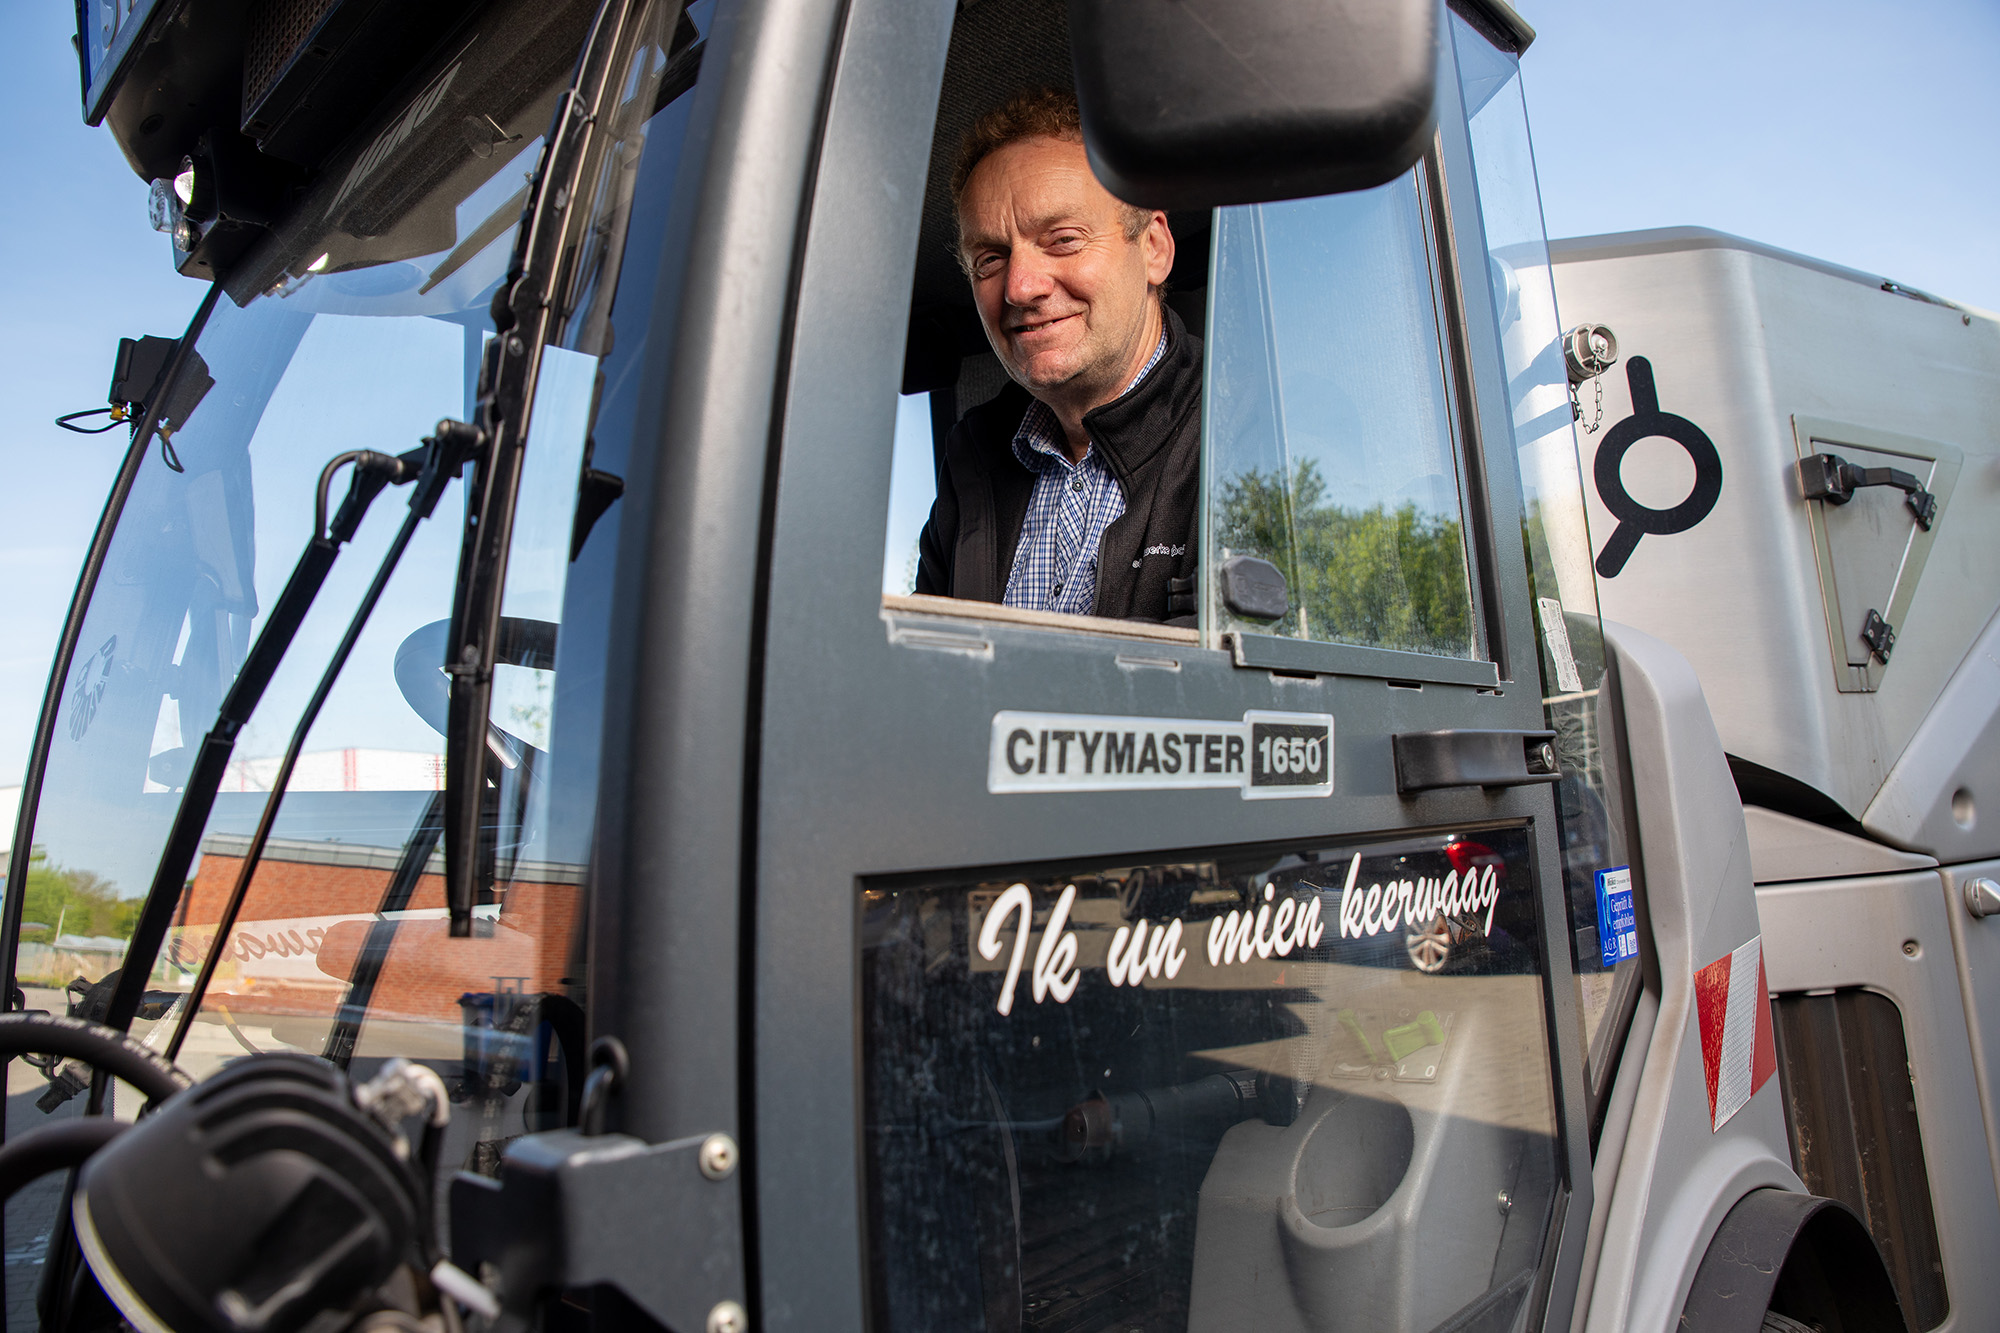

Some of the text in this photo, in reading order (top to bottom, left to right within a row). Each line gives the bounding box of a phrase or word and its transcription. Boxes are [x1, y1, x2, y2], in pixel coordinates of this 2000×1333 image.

[1006, 728, 1322, 775] CITYMASTER 1650
[978, 852, 1500, 1016] Ik un mien keerwaag
